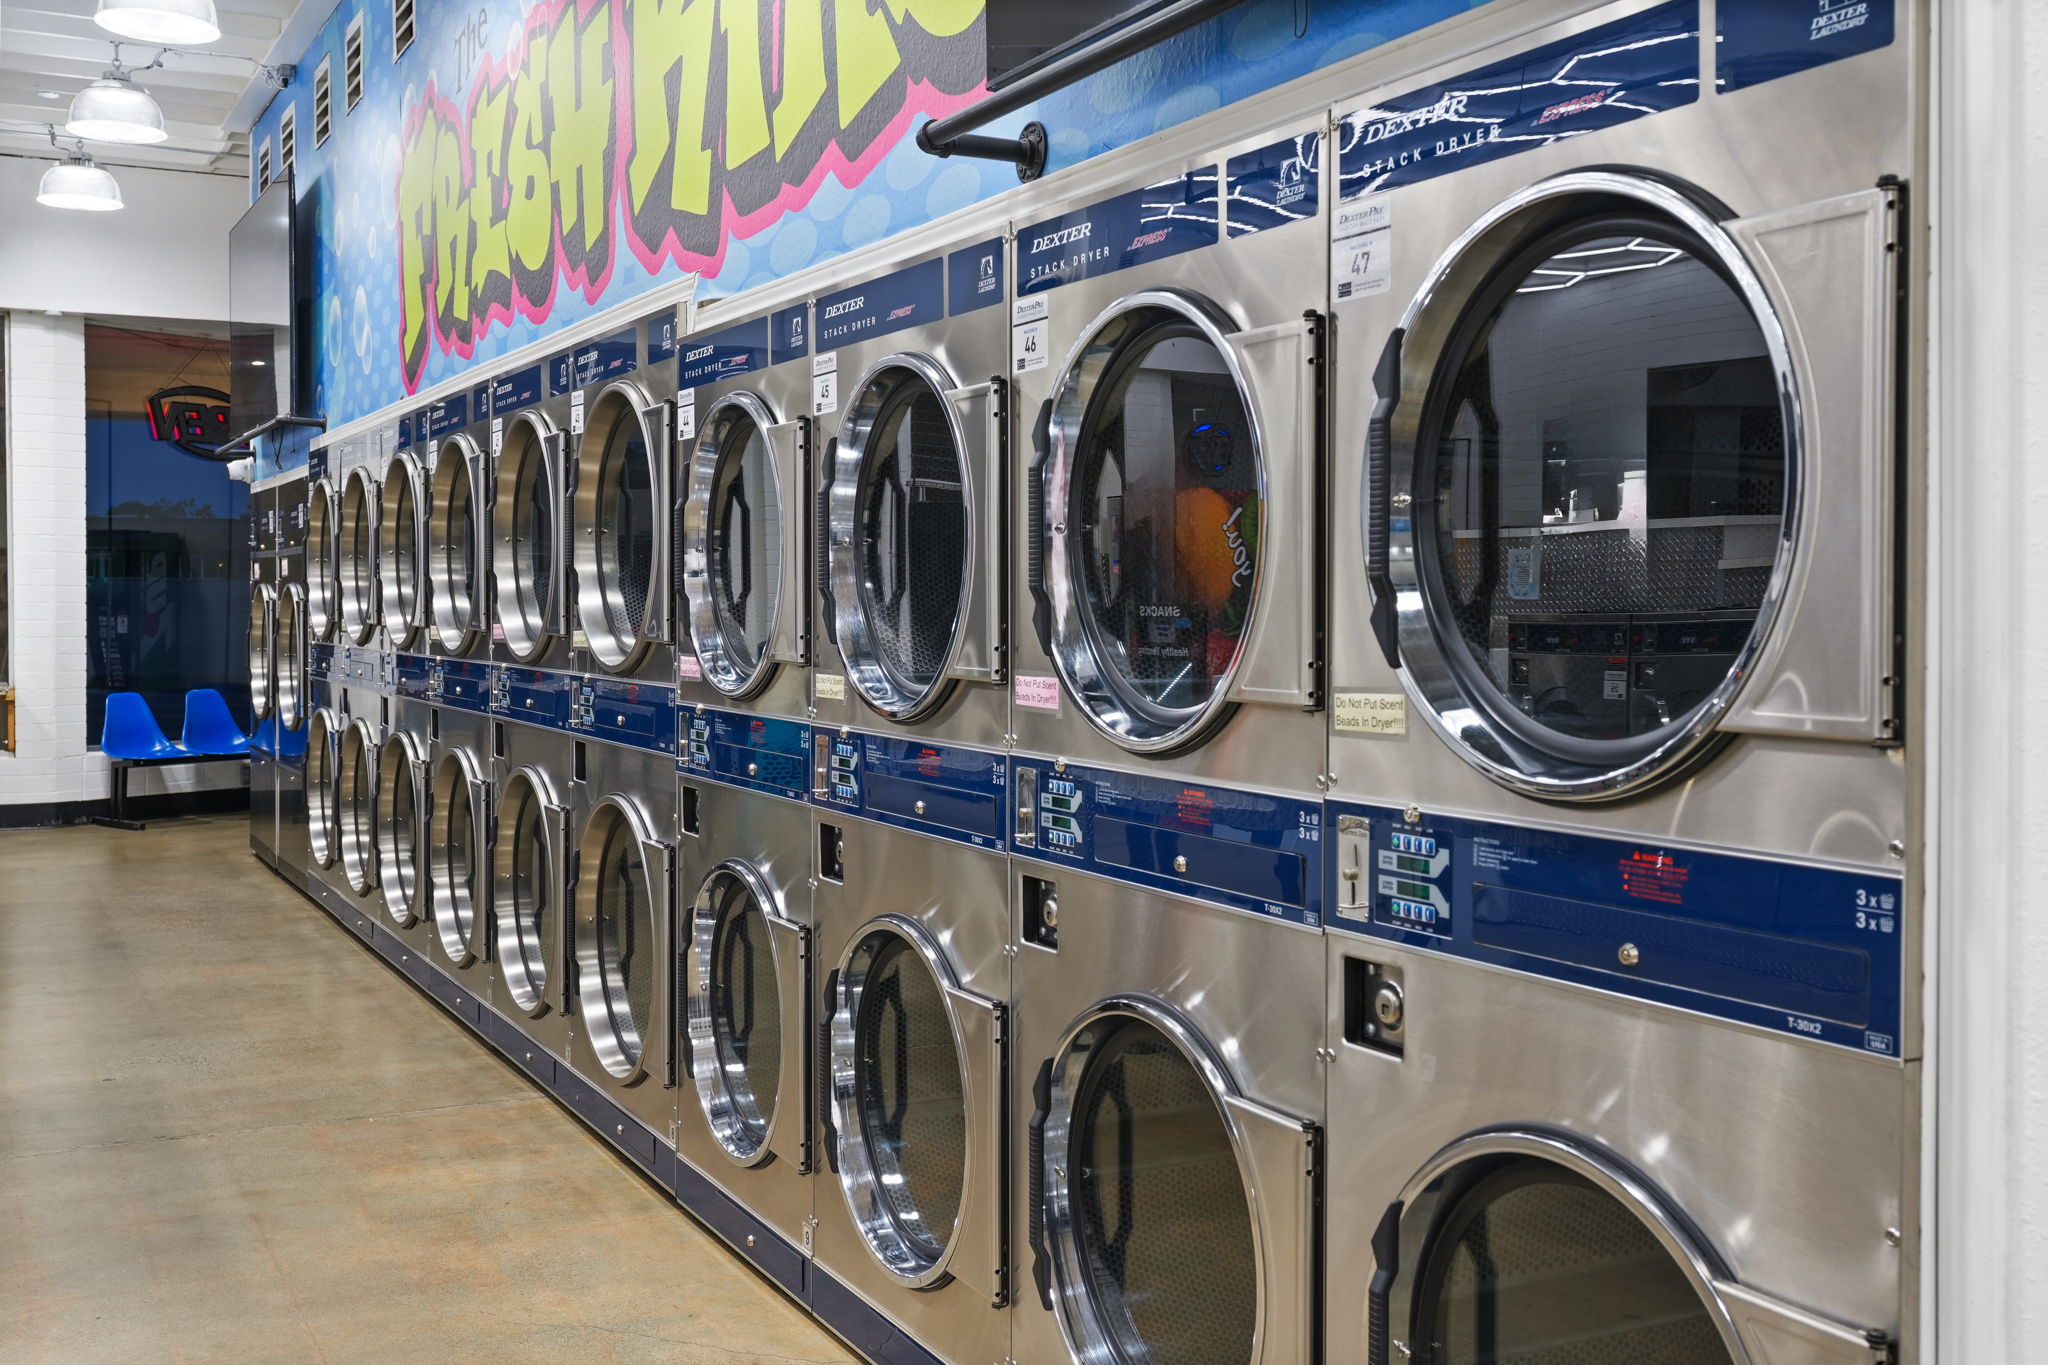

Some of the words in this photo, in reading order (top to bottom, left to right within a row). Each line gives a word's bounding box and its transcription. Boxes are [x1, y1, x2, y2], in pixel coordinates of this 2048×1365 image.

[1810, 3, 1868, 30] DEXTER
[1810, 13, 1869, 40] LAUNDRY
[453, 7, 487, 95] The
[1363, 94, 1468, 145] DEXTER
[1538, 89, 1608, 124] EXPRESS
[1363, 147, 1422, 178] STACK
[1436, 124, 1500, 155] DRYER
[397, 8, 613, 364] FRESH
[1276, 184, 1305, 199] DEXTER
[1276, 192, 1306, 206] LAUNDRY
[1030, 222, 1092, 254] DEXTER
[1131, 228, 1169, 249] EXPRESS
[1030, 259, 1066, 279] STACK
[1073, 246, 1110, 266] DRYER
[1351, 251, 1371, 275] 47
[978, 284, 995, 293] LAUNDRY
[979, 277, 995, 287] DEXTER
[824, 296, 864, 319] DEXTER
[824, 326, 848, 339] STACK
[852, 316, 876, 331] DRYER
[1025, 335, 1037, 354] 46
[578, 351, 598, 366] DEXTER
[685, 345, 714, 362] DEXTER
[685, 368, 702, 379] STACK
[705, 362, 722, 373] DRYER
[821, 384, 829, 399] 45
[683, 415, 689, 426] 44
[1023, 680, 1031, 688] Not
[1032, 680, 1041, 689] Put
[1041, 680, 1056, 690] Scent
[1336, 697, 1346, 708] Do
[1348, 698, 1361, 709] Not
[1363, 698, 1377, 709] Put
[1379, 698, 1403, 711] Scent
[1336, 715, 1359, 727] Beads
[1362, 716, 1369, 727] In
[993, 762, 997, 771] 3
[992, 775, 996, 784] 3
[1299, 811, 1305, 823] 3
[1306, 816, 1311, 824] x
[1299, 827, 1305, 839] 3
[1306, 832, 1311, 840] x
[1856, 889, 1866, 906] 3
[1869, 896, 1878, 907] x
[1855, 911, 1866, 928] 3
[1868, 919, 1877, 930] x
